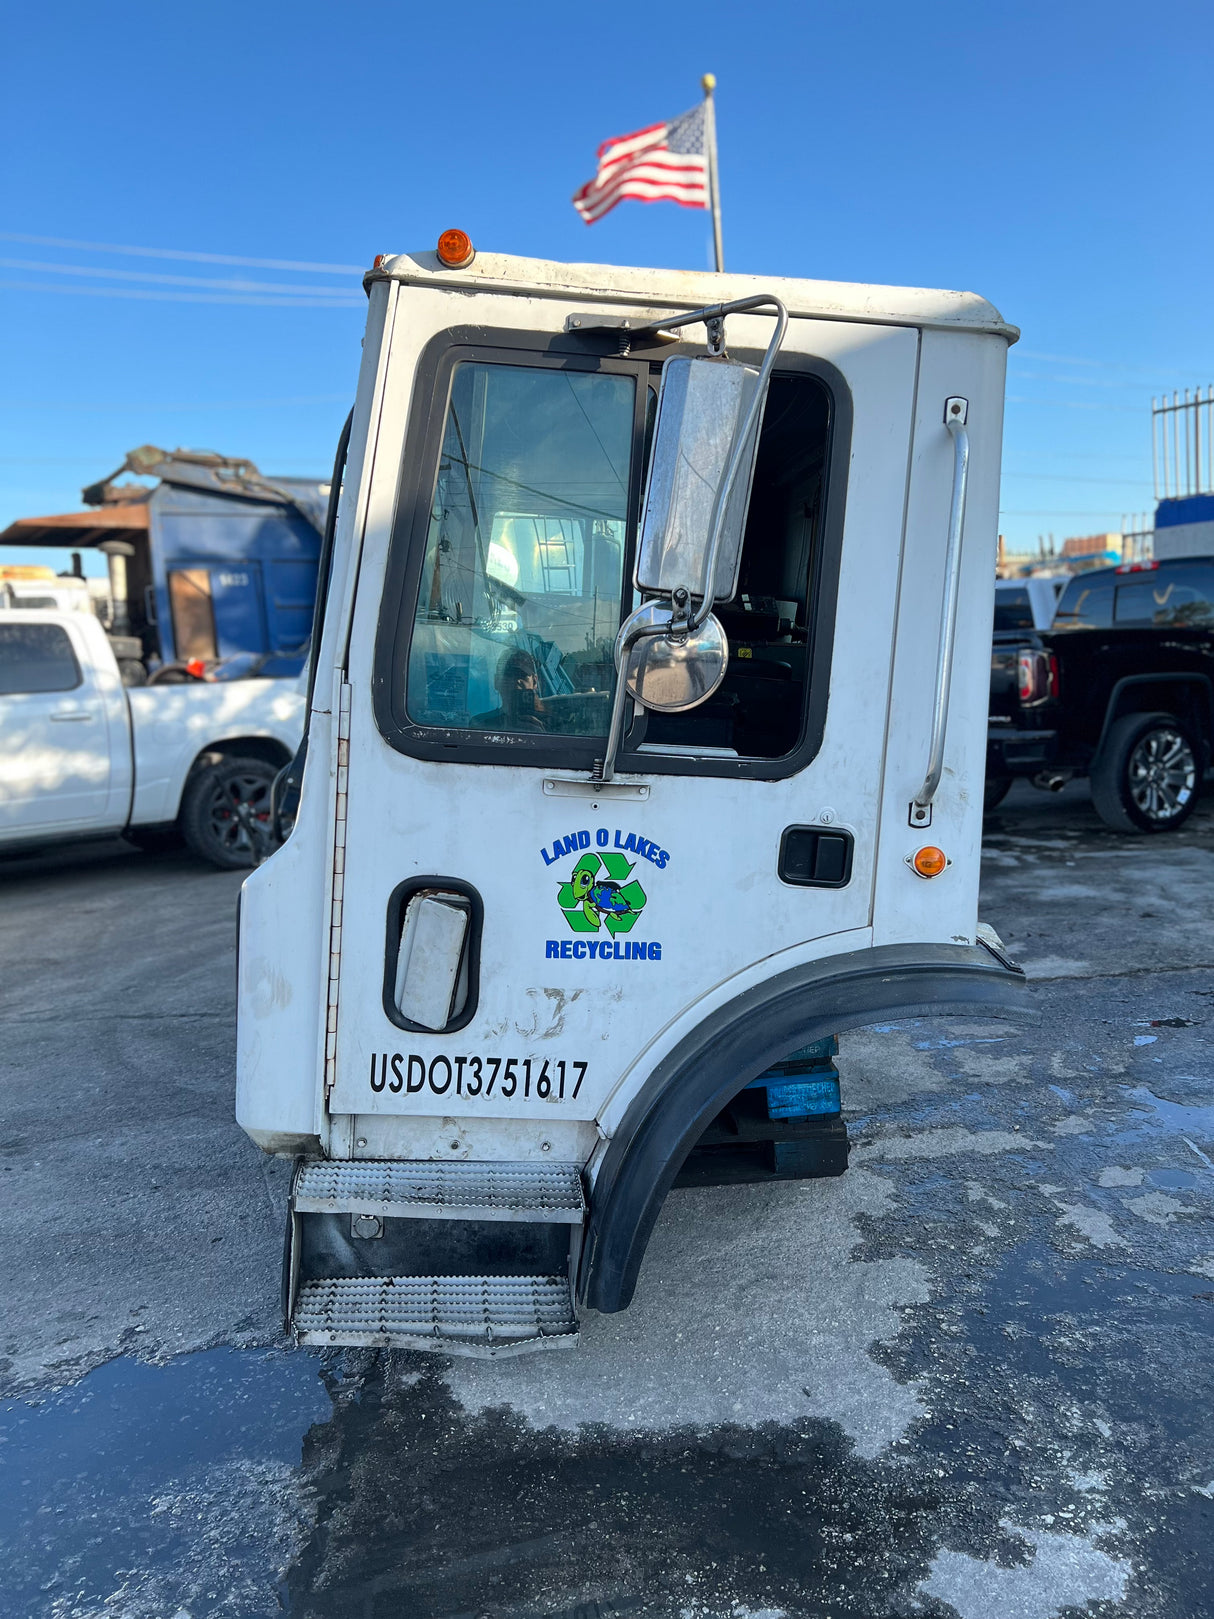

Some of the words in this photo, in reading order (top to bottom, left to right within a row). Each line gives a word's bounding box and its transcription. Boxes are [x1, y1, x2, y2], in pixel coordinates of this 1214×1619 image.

[540, 830, 591, 866] LAND
[596, 828, 609, 847] O
[614, 829, 671, 869] LAKES
[545, 940, 662, 961] RECYCLING
[370, 1053, 588, 1099] USDOT3751617
